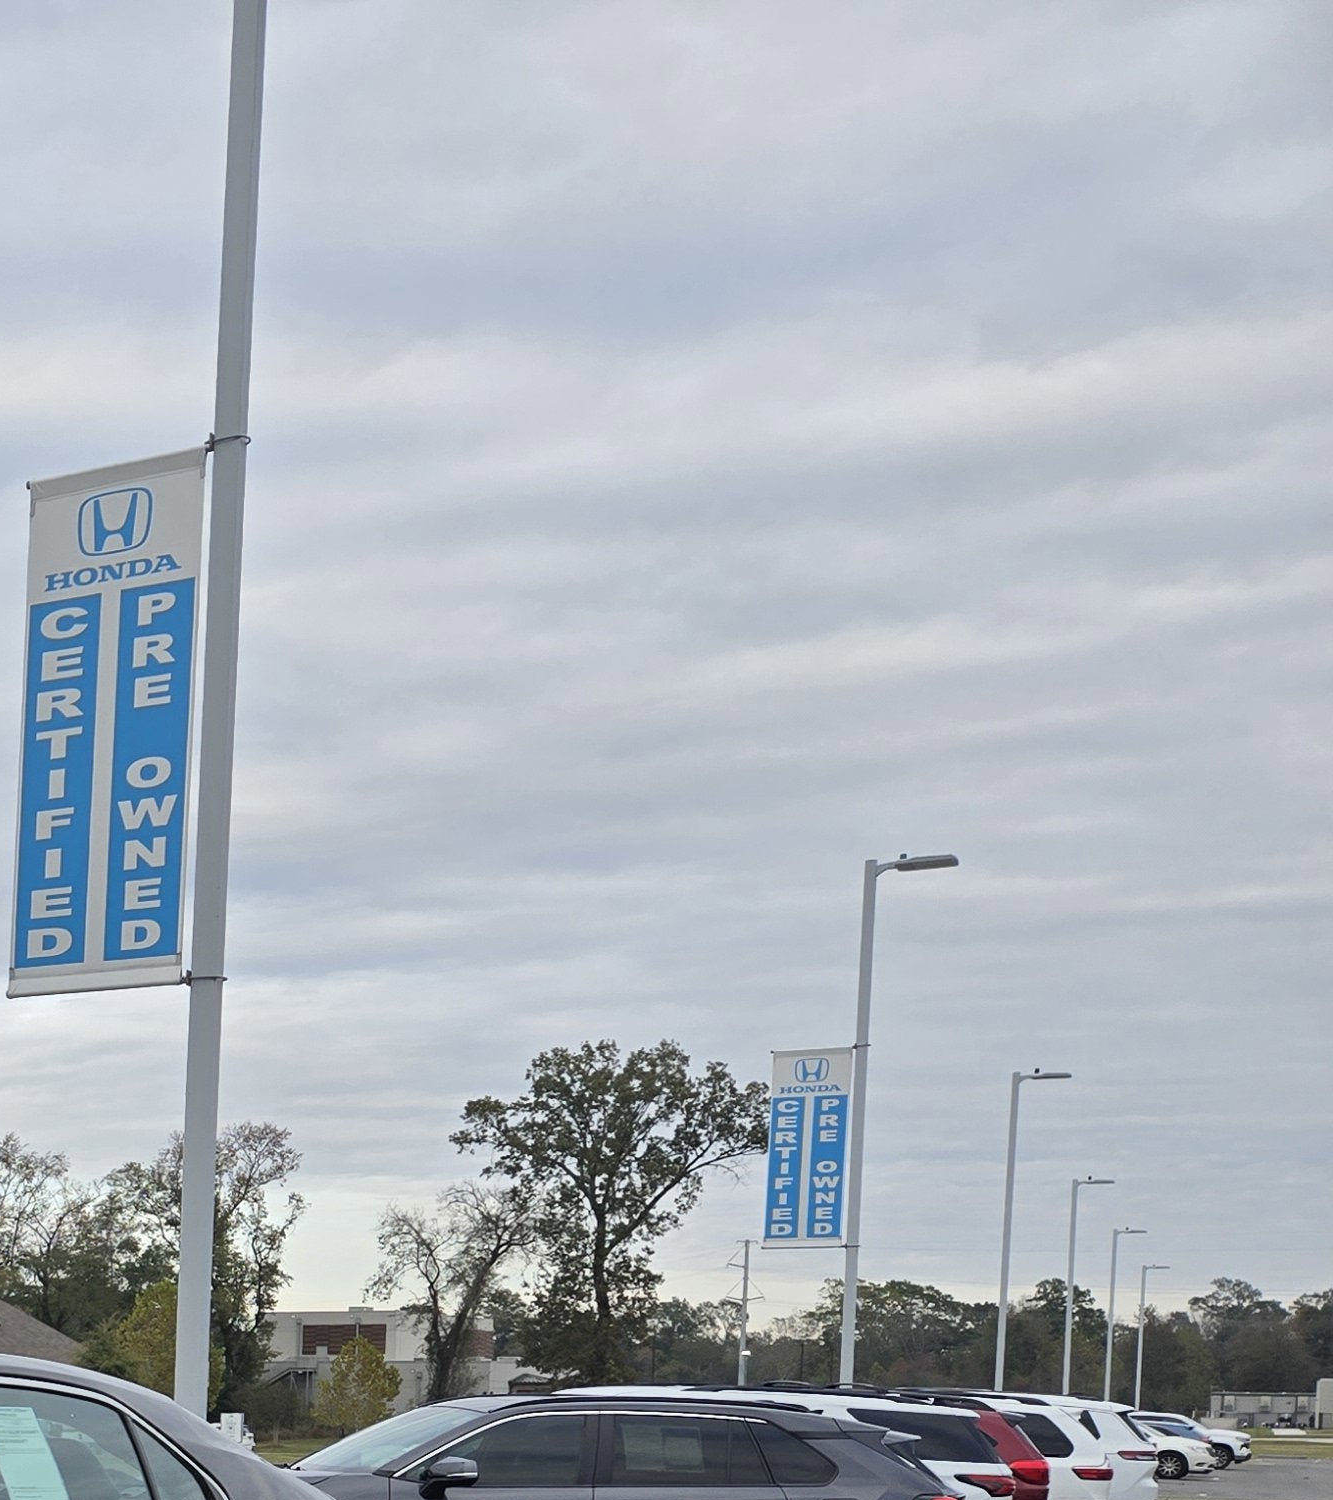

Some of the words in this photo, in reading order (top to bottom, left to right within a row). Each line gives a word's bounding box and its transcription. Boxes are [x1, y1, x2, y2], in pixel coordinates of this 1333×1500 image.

[44, 553, 182, 592] HONDA
[132, 592, 177, 709] PRE
[26, 606, 89, 960] CERTIFIED
[117, 755, 178, 952] OWNED
[779, 1084, 842, 1095] HONDA
[819, 1098, 840, 1142] PRE
[770, 1100, 800, 1236] CERTIFIED
[812, 1160, 840, 1236] OWNED
